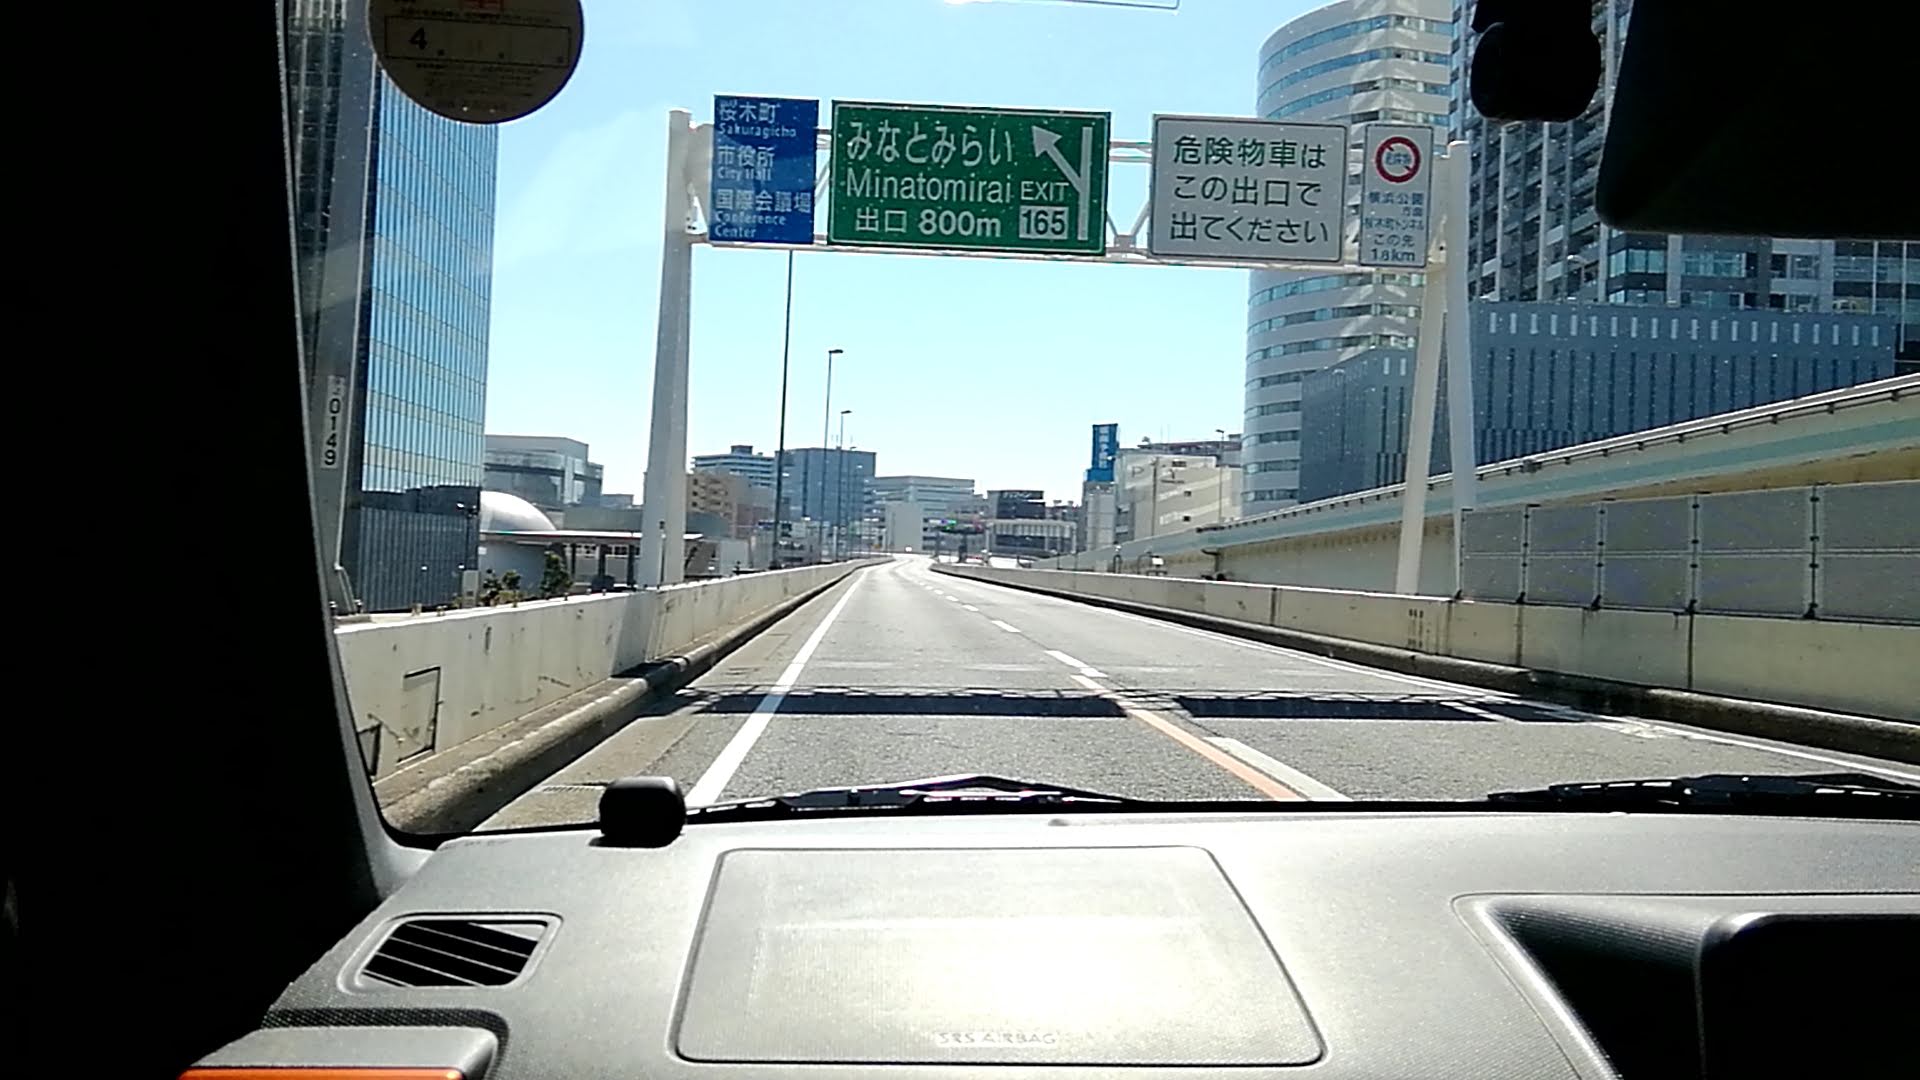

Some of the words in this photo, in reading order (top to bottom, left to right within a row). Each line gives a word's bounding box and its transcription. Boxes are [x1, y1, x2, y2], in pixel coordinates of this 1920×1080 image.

[409, 27, 428, 50] 4
[719, 100, 777, 124] 桜木町
[718, 122, 797, 139] Sakuragicho
[847, 119, 1013, 167] みなとみらい
[717, 145, 774, 167] 市役所
[1173, 135, 1326, 169] 危険物車は
[717, 166, 741, 182] City
[745, 167, 772, 182] Hall
[846, 167, 1011, 204] Minatomirai
[716, 188, 811, 214] 国際会議場
[1020, 181, 1069, 202] EXIT
[1174, 175, 1322, 208] この出口で
[715, 210, 786, 226] Conference
[855, 206, 907, 233] 出口
[918, 208, 1001, 238] 800m
[1022, 210, 1065, 236] 165
[1169, 211, 1328, 243] 出てください
[714, 224, 757, 238] Center
[1373, 233, 1416, 248] この先
[324, 398, 341, 466] 0149
